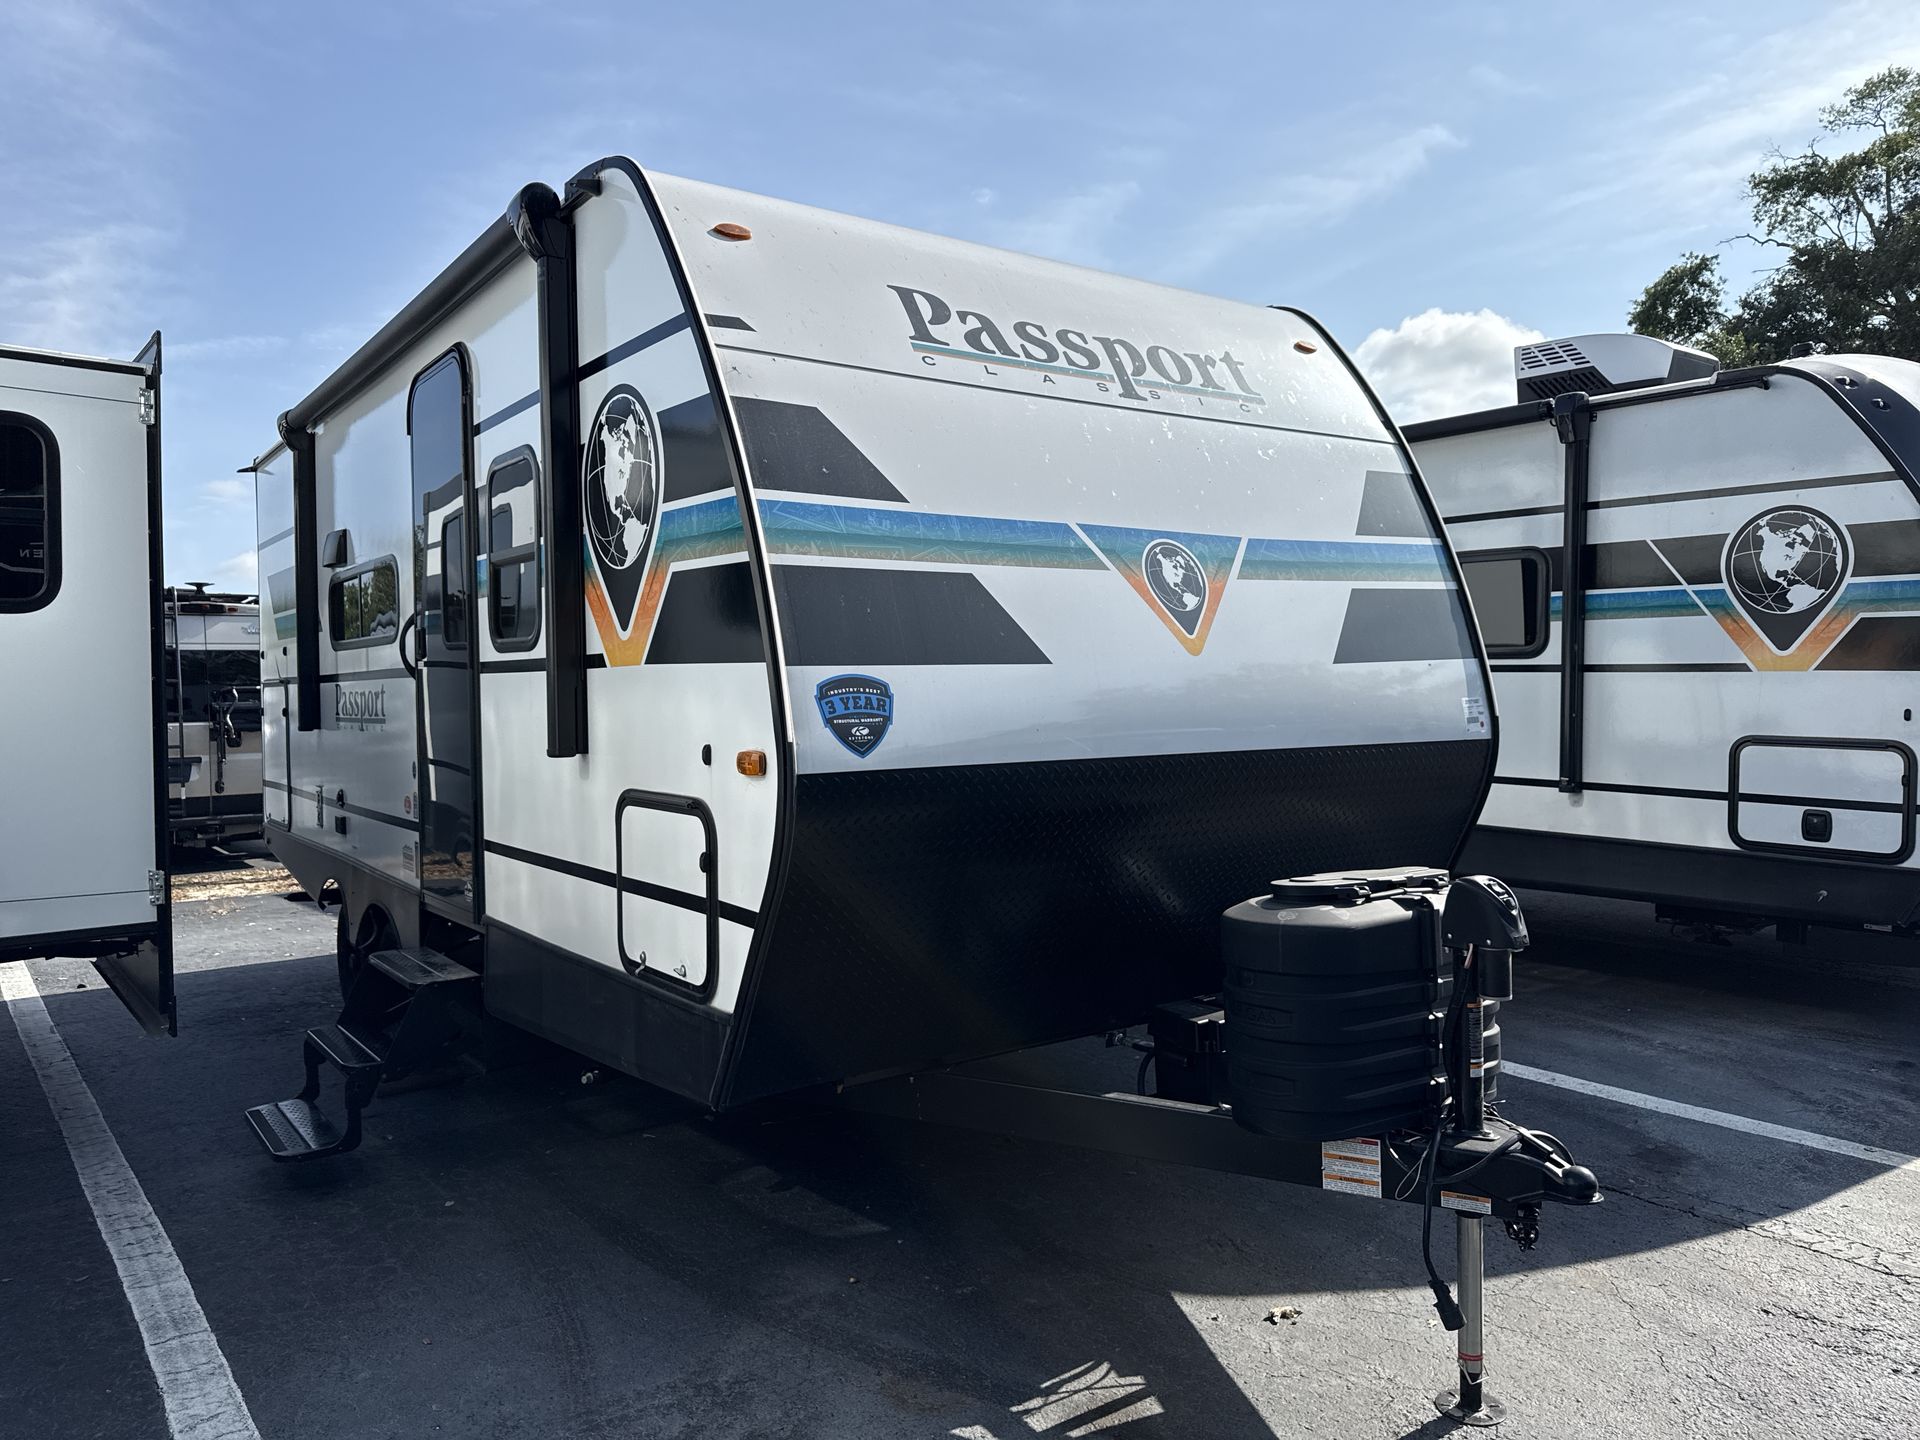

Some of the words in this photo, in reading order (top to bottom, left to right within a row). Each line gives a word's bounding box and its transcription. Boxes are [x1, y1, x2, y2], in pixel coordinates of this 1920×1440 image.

[887, 284, 1262, 402] Passport
[921, 354, 1252, 414] CLASSIC
[335, 683, 386, 732] Passport
[824, 700, 837, 715] 3
[839, 696, 887, 712] YEAR
[827, 687, 863, 695] INDUSTRY'S
